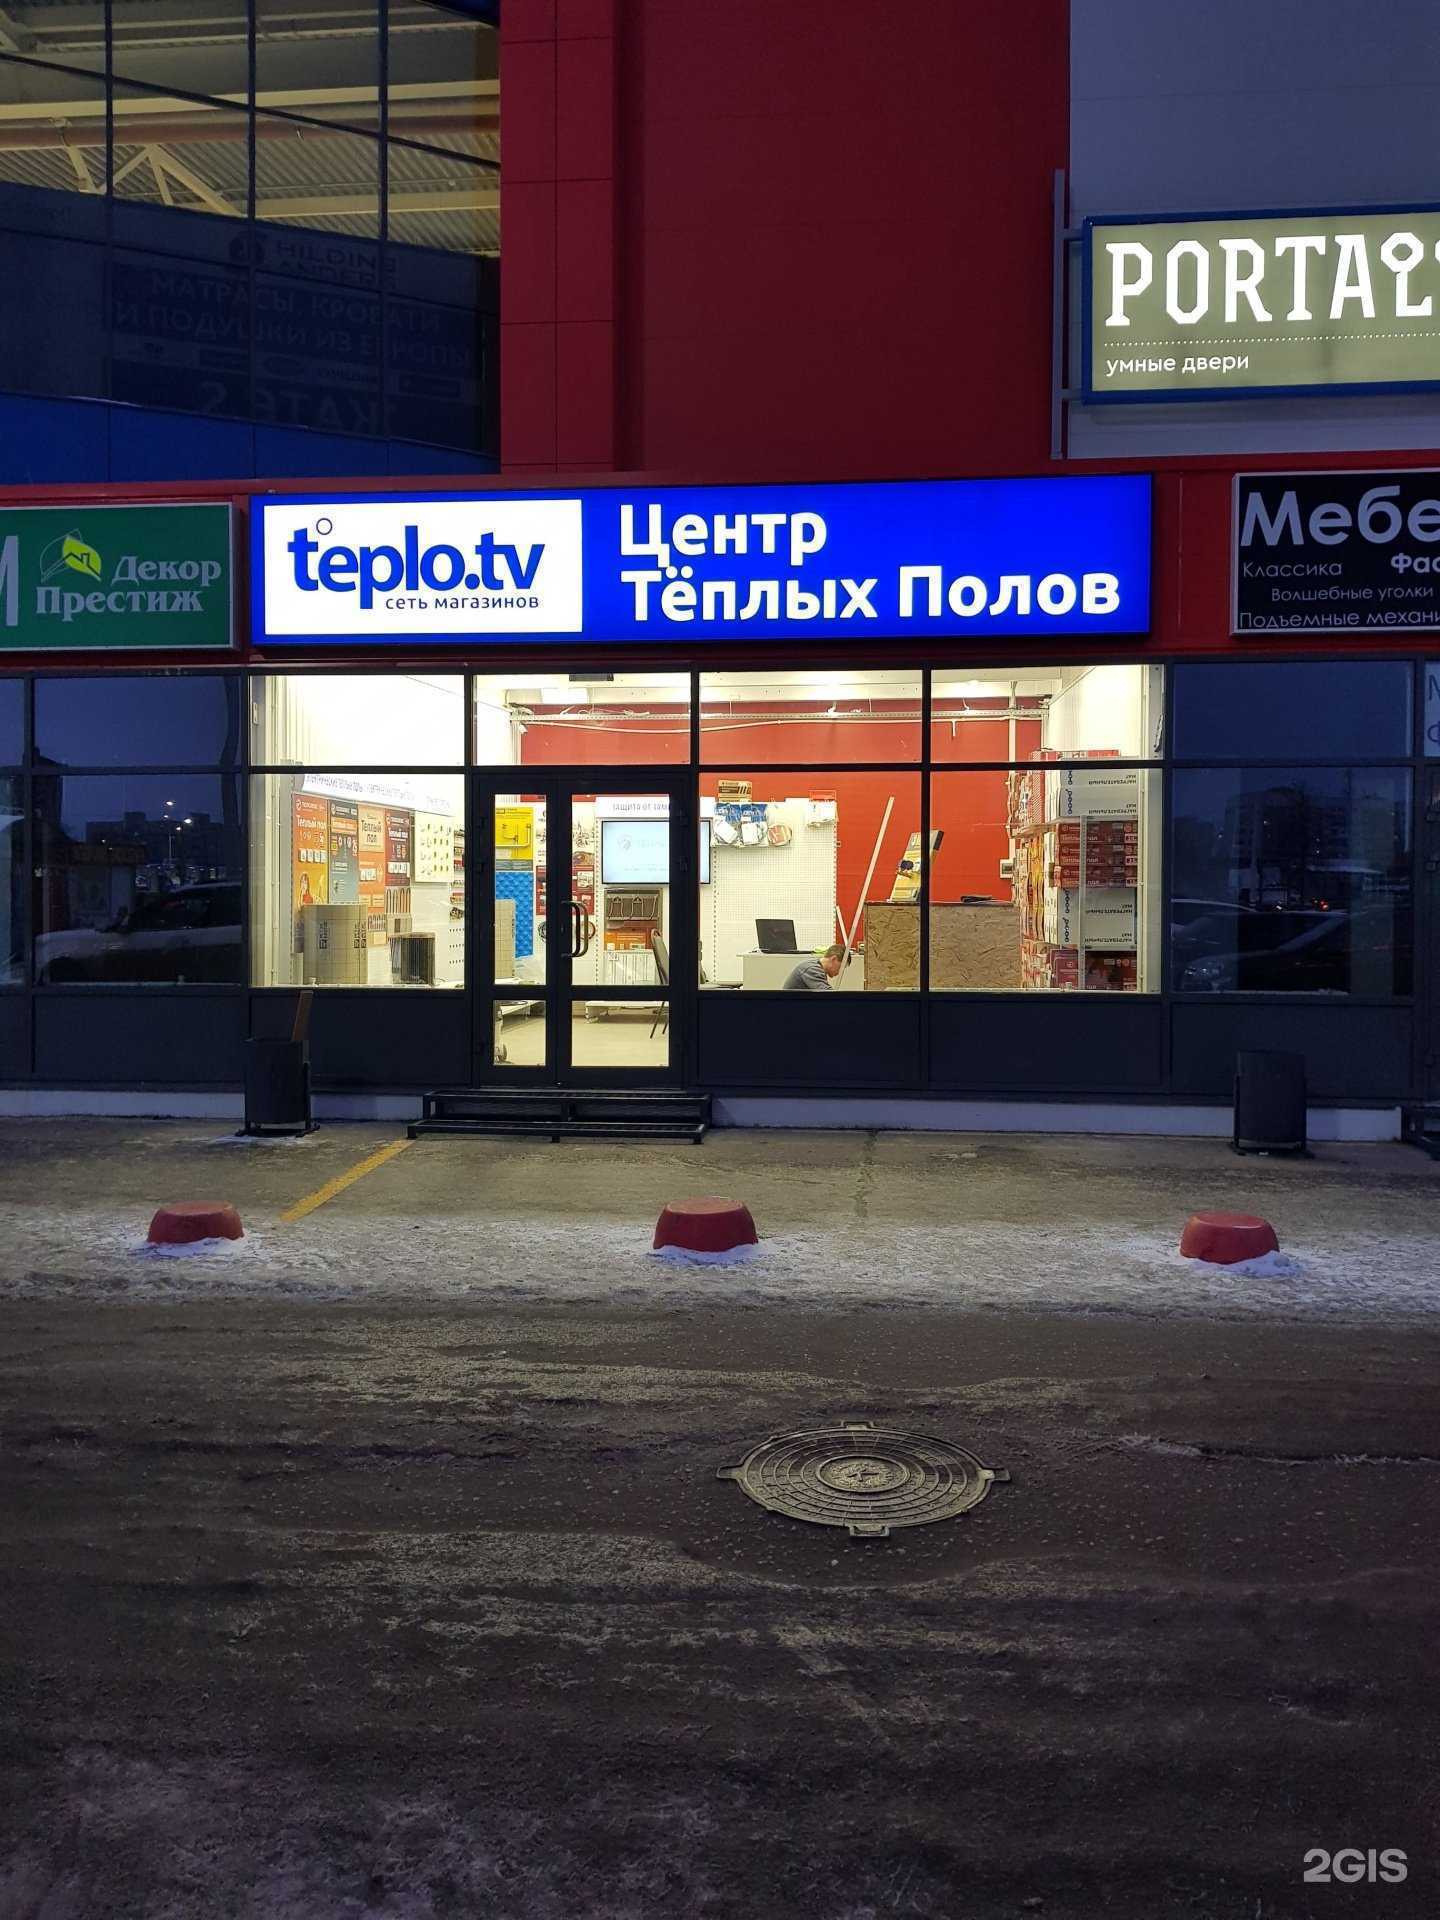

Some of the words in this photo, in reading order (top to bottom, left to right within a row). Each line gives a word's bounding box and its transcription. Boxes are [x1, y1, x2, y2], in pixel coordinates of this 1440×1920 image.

[1105, 231, 1440, 326] PORTAL
[1106, 356, 1176, 377] умные
[1182, 354, 1249, 373] двери
[620, 504, 827, 567] Центр
[111, 556, 222, 587] Декор
[288, 525, 546, 609] teplo.tv
[1243, 562, 1343, 577] Классика
[36, 586, 204, 622] Престиж
[386, 596, 428, 610] сеть
[434, 596, 539, 609] магазинов
[620, 566, 878, 622] Тёплых
[899, 566, 1120, 618] Полов
[1271, 586, 1373, 602] Волшебные
[1377, 586, 1434, 602] уголки
[1239, 612, 1360, 629] Подъемные
